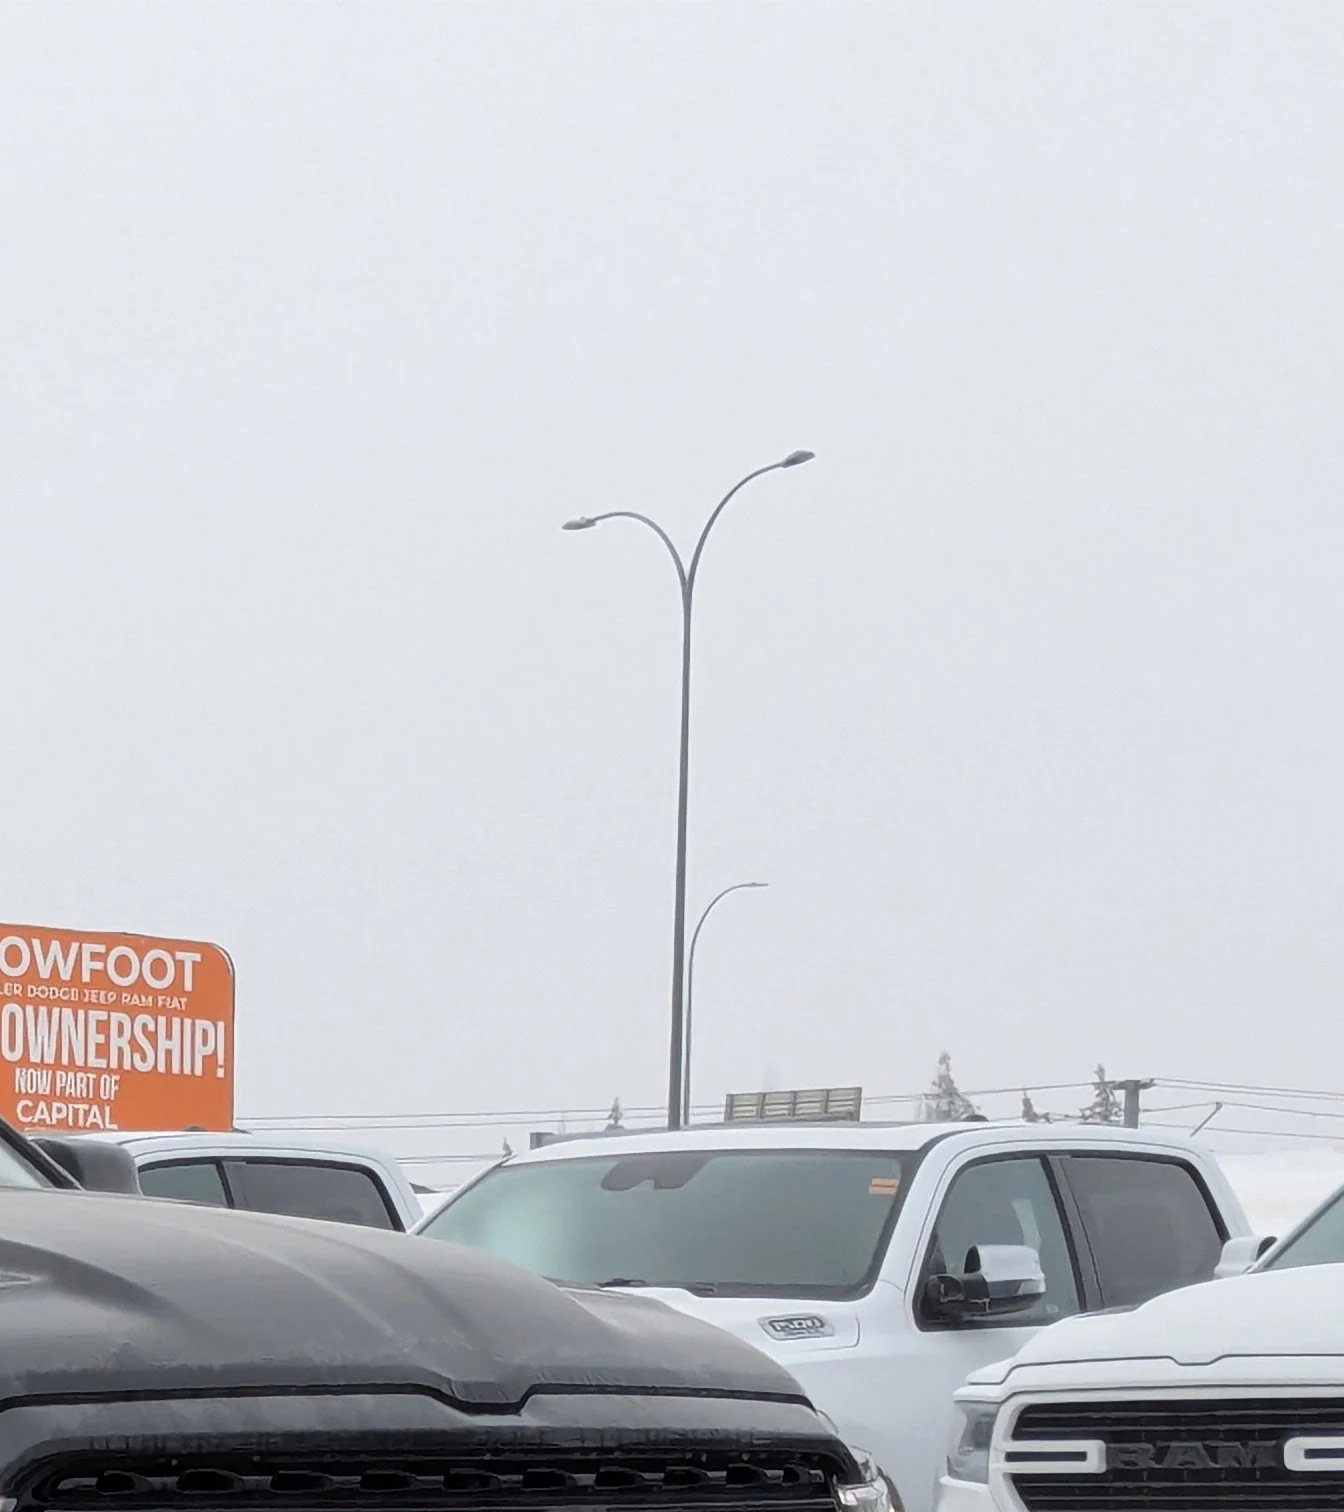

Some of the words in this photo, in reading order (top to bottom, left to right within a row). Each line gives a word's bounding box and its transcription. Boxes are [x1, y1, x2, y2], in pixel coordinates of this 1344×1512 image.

[27, 985, 79, 1001] DODGE
[83, 988, 117, 1005] JEEP
[121, 993, 153, 1008] RAM
[157, 995, 188, 1011] FIAT
[0, 1002, 226, 1079] OWNERSHIP!
[15, 1067, 52, 1095] NOW
[55, 1070, 97, 1099] PART
[99, 1074, 120, 1101] OF
[16, 1099, 119, 1130] CAPITAL
[1107, 1441, 1277, 1469] RAM
